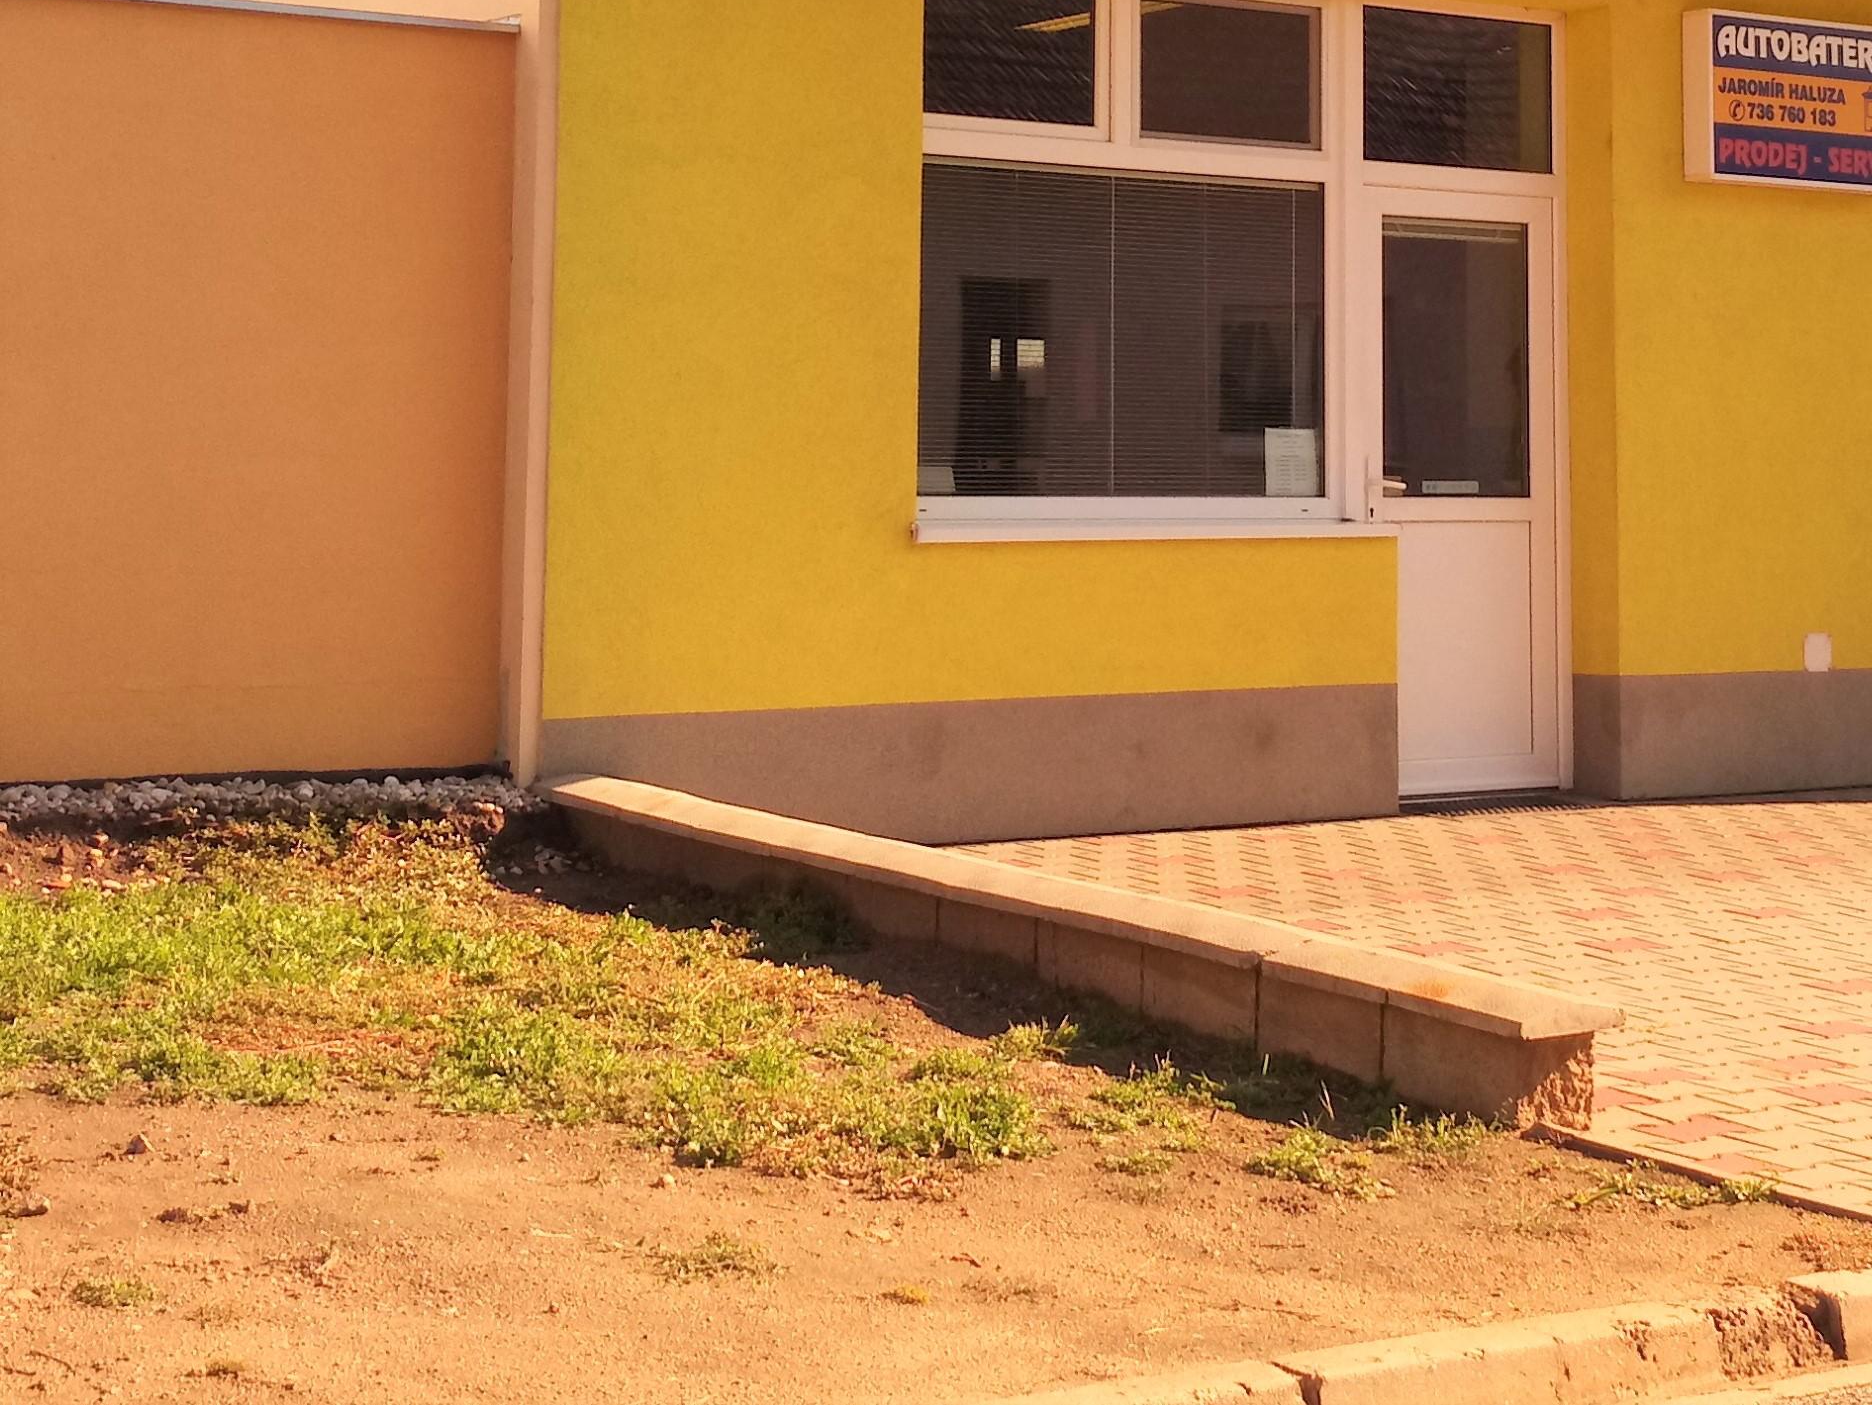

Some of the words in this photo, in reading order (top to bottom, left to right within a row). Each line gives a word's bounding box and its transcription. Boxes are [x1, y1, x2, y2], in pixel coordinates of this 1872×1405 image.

[1718, 77, 1784, 99] JAROMÍR
[1789, 84, 1846, 105] HALUZA
[1748, 103, 1774, 121] 736
[1780, 105, 1805, 123] 760
[1811, 110, 1836, 127] 183
[1719, 138, 1808, 175] PRODEJ
